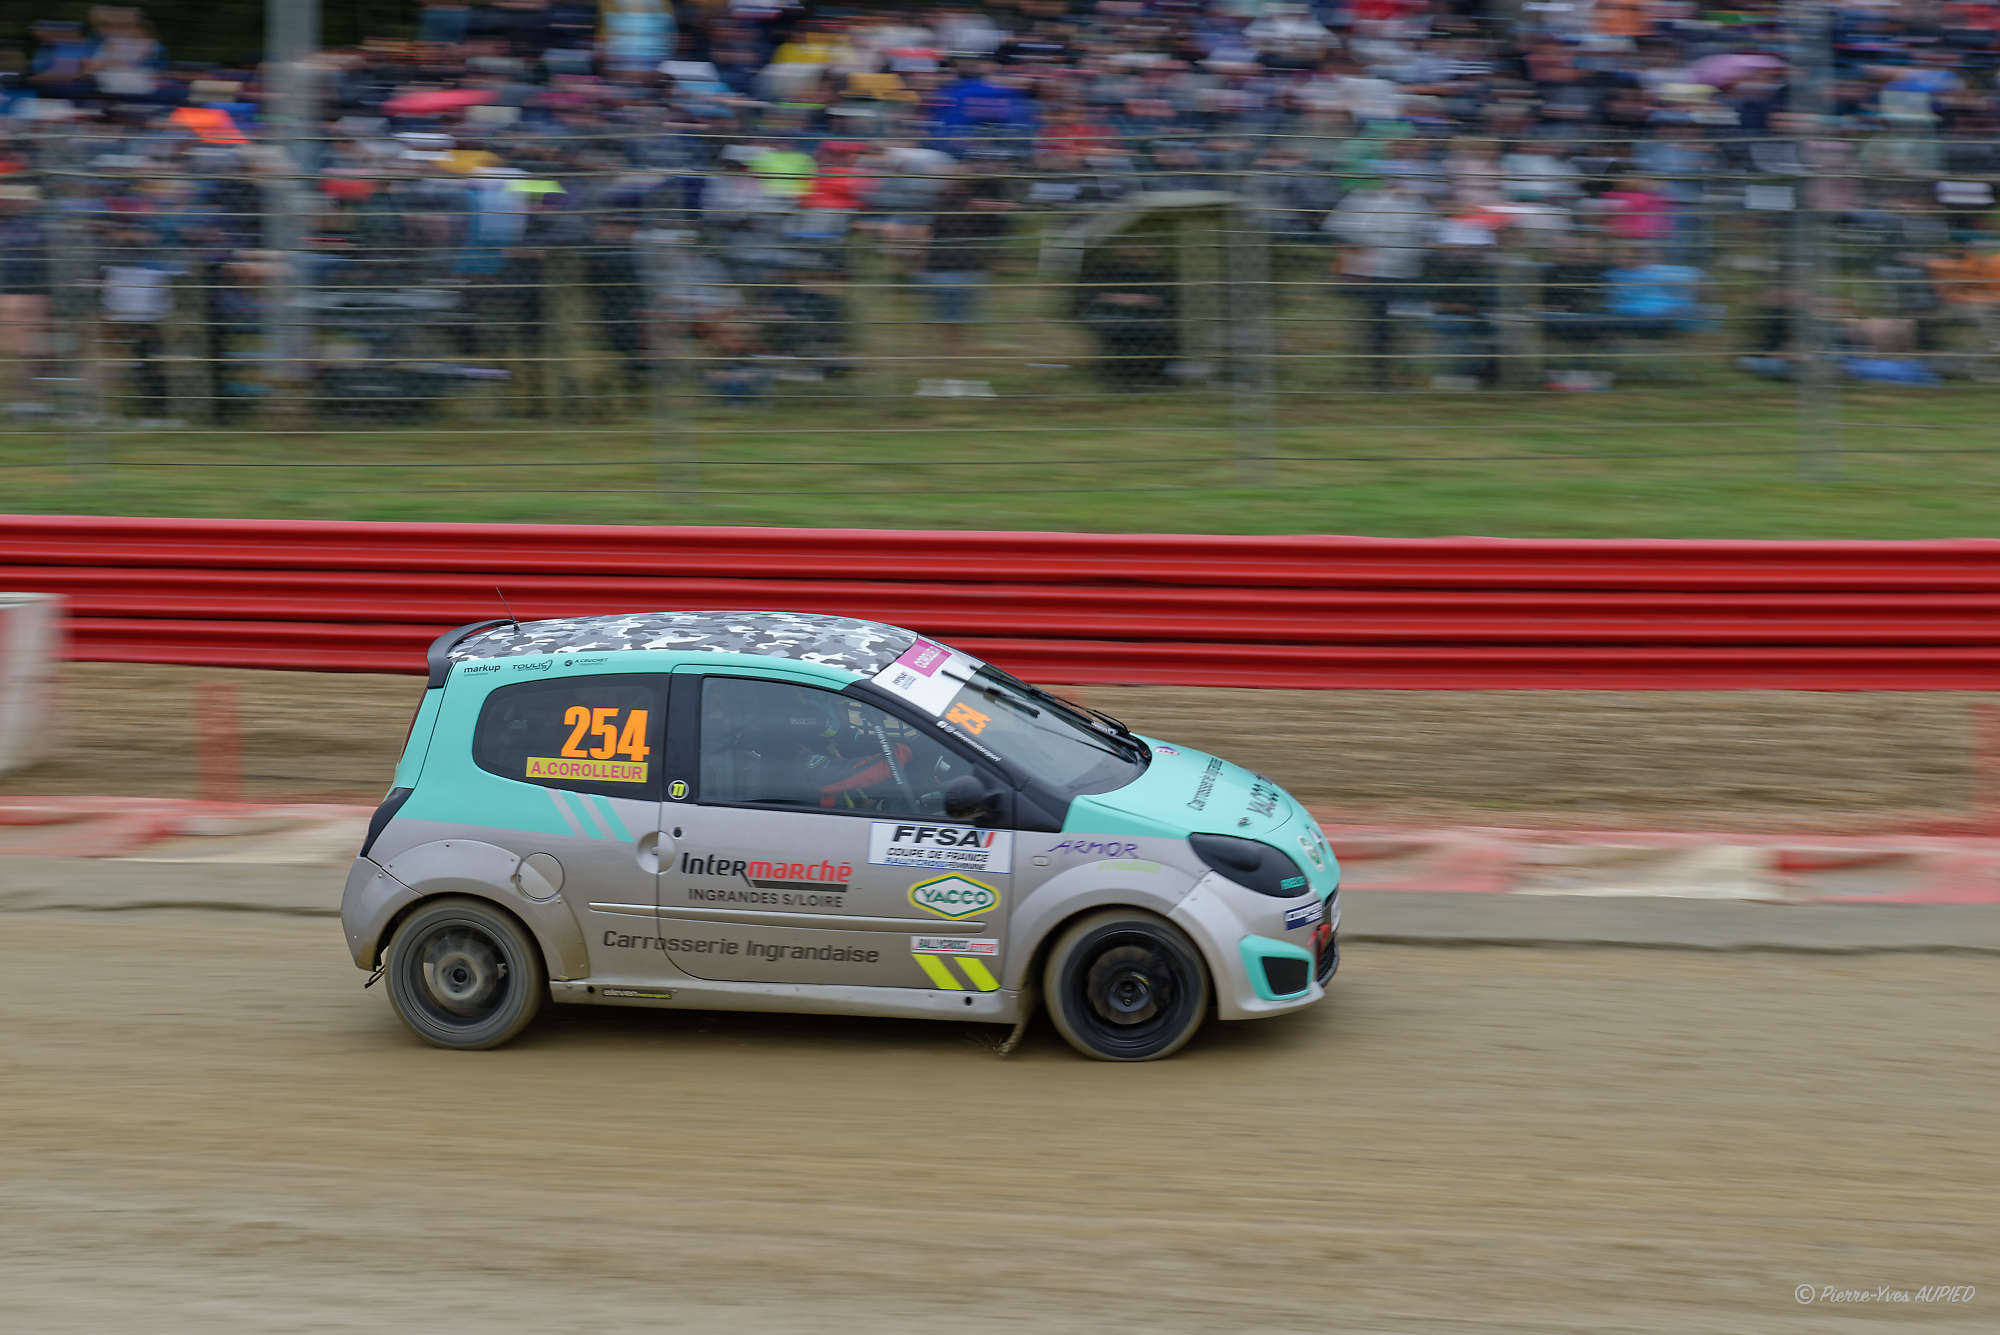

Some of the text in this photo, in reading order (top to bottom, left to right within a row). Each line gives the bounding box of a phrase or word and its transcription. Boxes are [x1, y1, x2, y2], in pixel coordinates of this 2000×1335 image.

[464, 664, 501, 673] markup
[560, 705, 650, 761] 254
[530, 761, 643, 780] A.COROLLEUR
[892, 825, 981, 847] FFSA
[886, 847, 989, 863] COUPE DE FRANCE
[1047, 840, 1140, 859] ARMOR
[681, 852, 853, 885] Intermarché
[688, 888, 844, 907] INGRANDES S/LOIRE
[921, 888, 989, 905] YACCO
[603, 930, 880, 963] Carrosserie Ingrandaise
